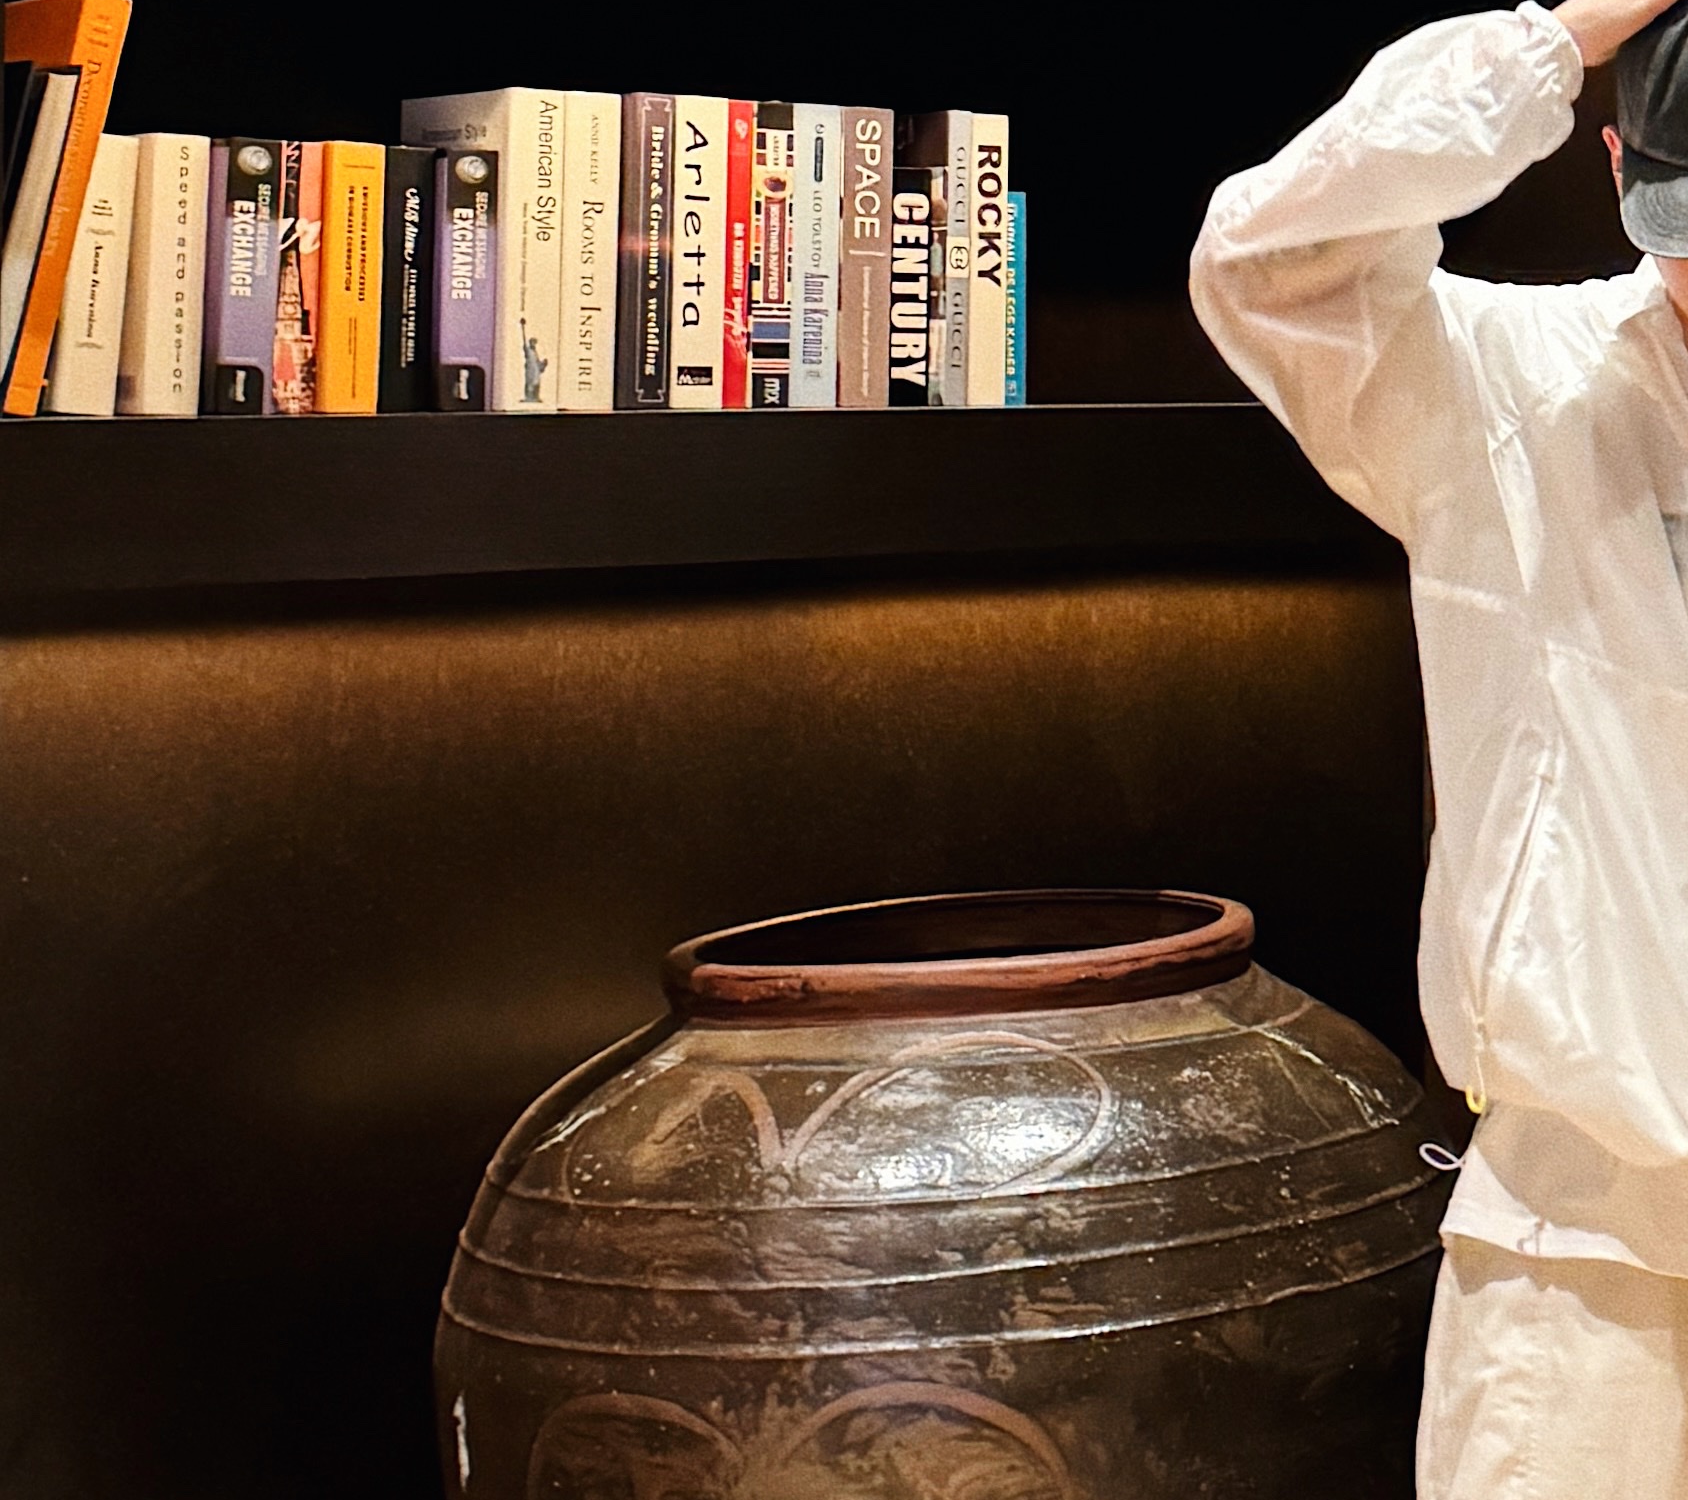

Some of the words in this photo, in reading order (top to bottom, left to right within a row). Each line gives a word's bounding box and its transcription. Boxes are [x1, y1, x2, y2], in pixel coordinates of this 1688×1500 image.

[536, 99, 558, 189] American
[651, 125, 666, 181] Bride
[853, 117, 883, 239] SPACE
[177, 146, 191, 226] Speed
[531, 195, 557, 243] Style
[651, 182, 664, 200] &
[681, 120, 711, 328] Arletta
[812, 190, 824, 213] LEO
[954, 145, 966, 224] GUCCI
[976, 143, 1002, 288] ROCKY
[175, 237, 187, 281] and
[230, 200, 256, 298] EXCHANGE
[452, 207, 475, 300] EXCHANGE
[580, 199, 605, 266] ROOMS
[812, 214, 824, 269] TOLSTOY
[579, 272, 595, 297] TO
[803, 270, 830, 305] Anna
[889, 191, 931, 388] CENTURY
[577, 304, 602, 393] INSPIRE
[645, 298, 660, 377] wedding
[802, 306, 829, 366] Karenina
[950, 290, 963, 369] GUCCI
[1005, 327, 1015, 376] KAMER
